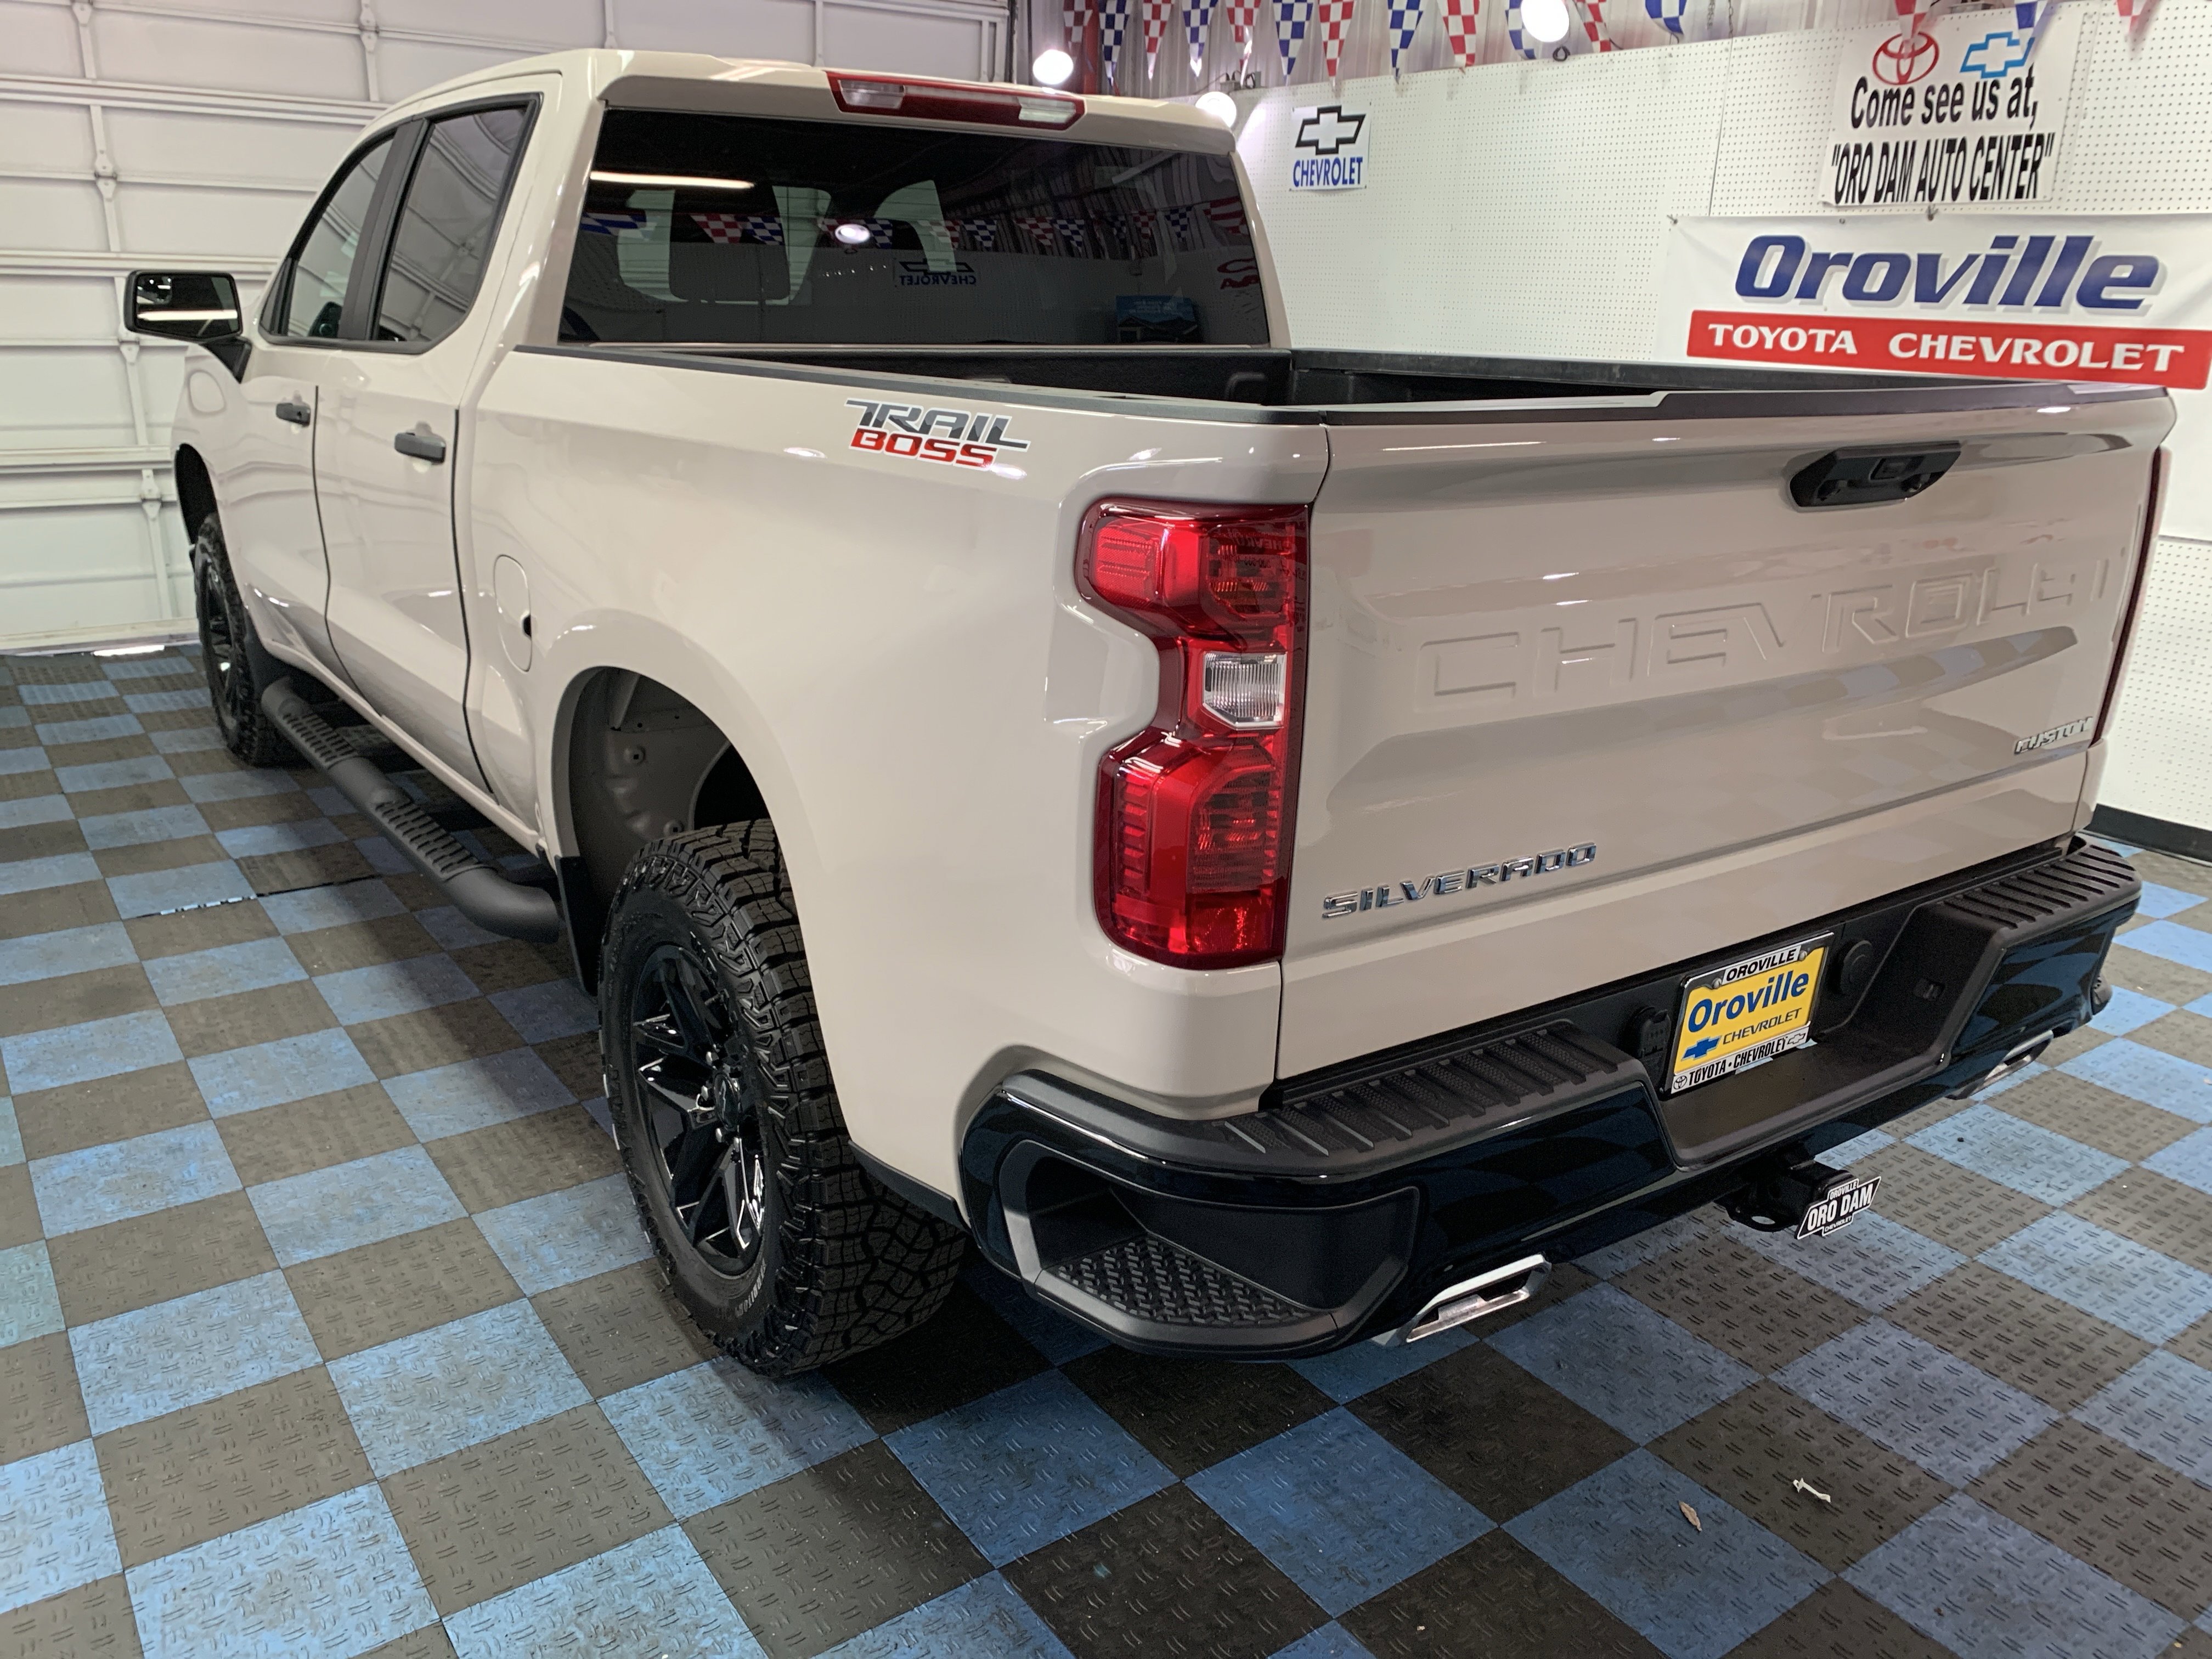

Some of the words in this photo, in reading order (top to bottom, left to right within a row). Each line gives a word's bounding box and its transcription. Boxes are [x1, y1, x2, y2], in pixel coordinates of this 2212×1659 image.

[1851, 76, 1915, 129] Come
[1921, 82, 1963, 125] see
[1972, 79, 2001, 121] us
[2007, 63, 2039, 131] at,
[1293, 156, 1363, 188] CHEVROLET
[1831, 142, 1874, 205] "ORO
[1874, 140, 1915, 203] DAM
[1915, 137, 1968, 202] AUTO
[1969, 133, 2055, 201] CENTER"
[1735, 234, 2163, 311] Oroville
[1708, 324, 1858, 355] TOYOTA
[1888, 332, 2185, 373] CHEVROLET
[844, 398, 1031, 452] TRAIL
[849, 427, 997, 471] BOSS
[1322, 842, 1597, 918] SILVERADO
[1726, 949, 1797, 981] OROVILLE
[1688, 970, 1809, 1033] Oroville
[1723, 1008, 1802, 1045] CHEVROLET
[1689, 1060, 1726, 1086] TOYOTA
[1733, 1037, 1788, 1069] CHEVROLET
[1807, 1200, 1838, 1231] ORO
[1840, 1183, 1874, 1216] DAM
[1830, 1181, 1857, 1200] OROVILLE
[1824, 1216, 1852, 1232] CHEVROLET
